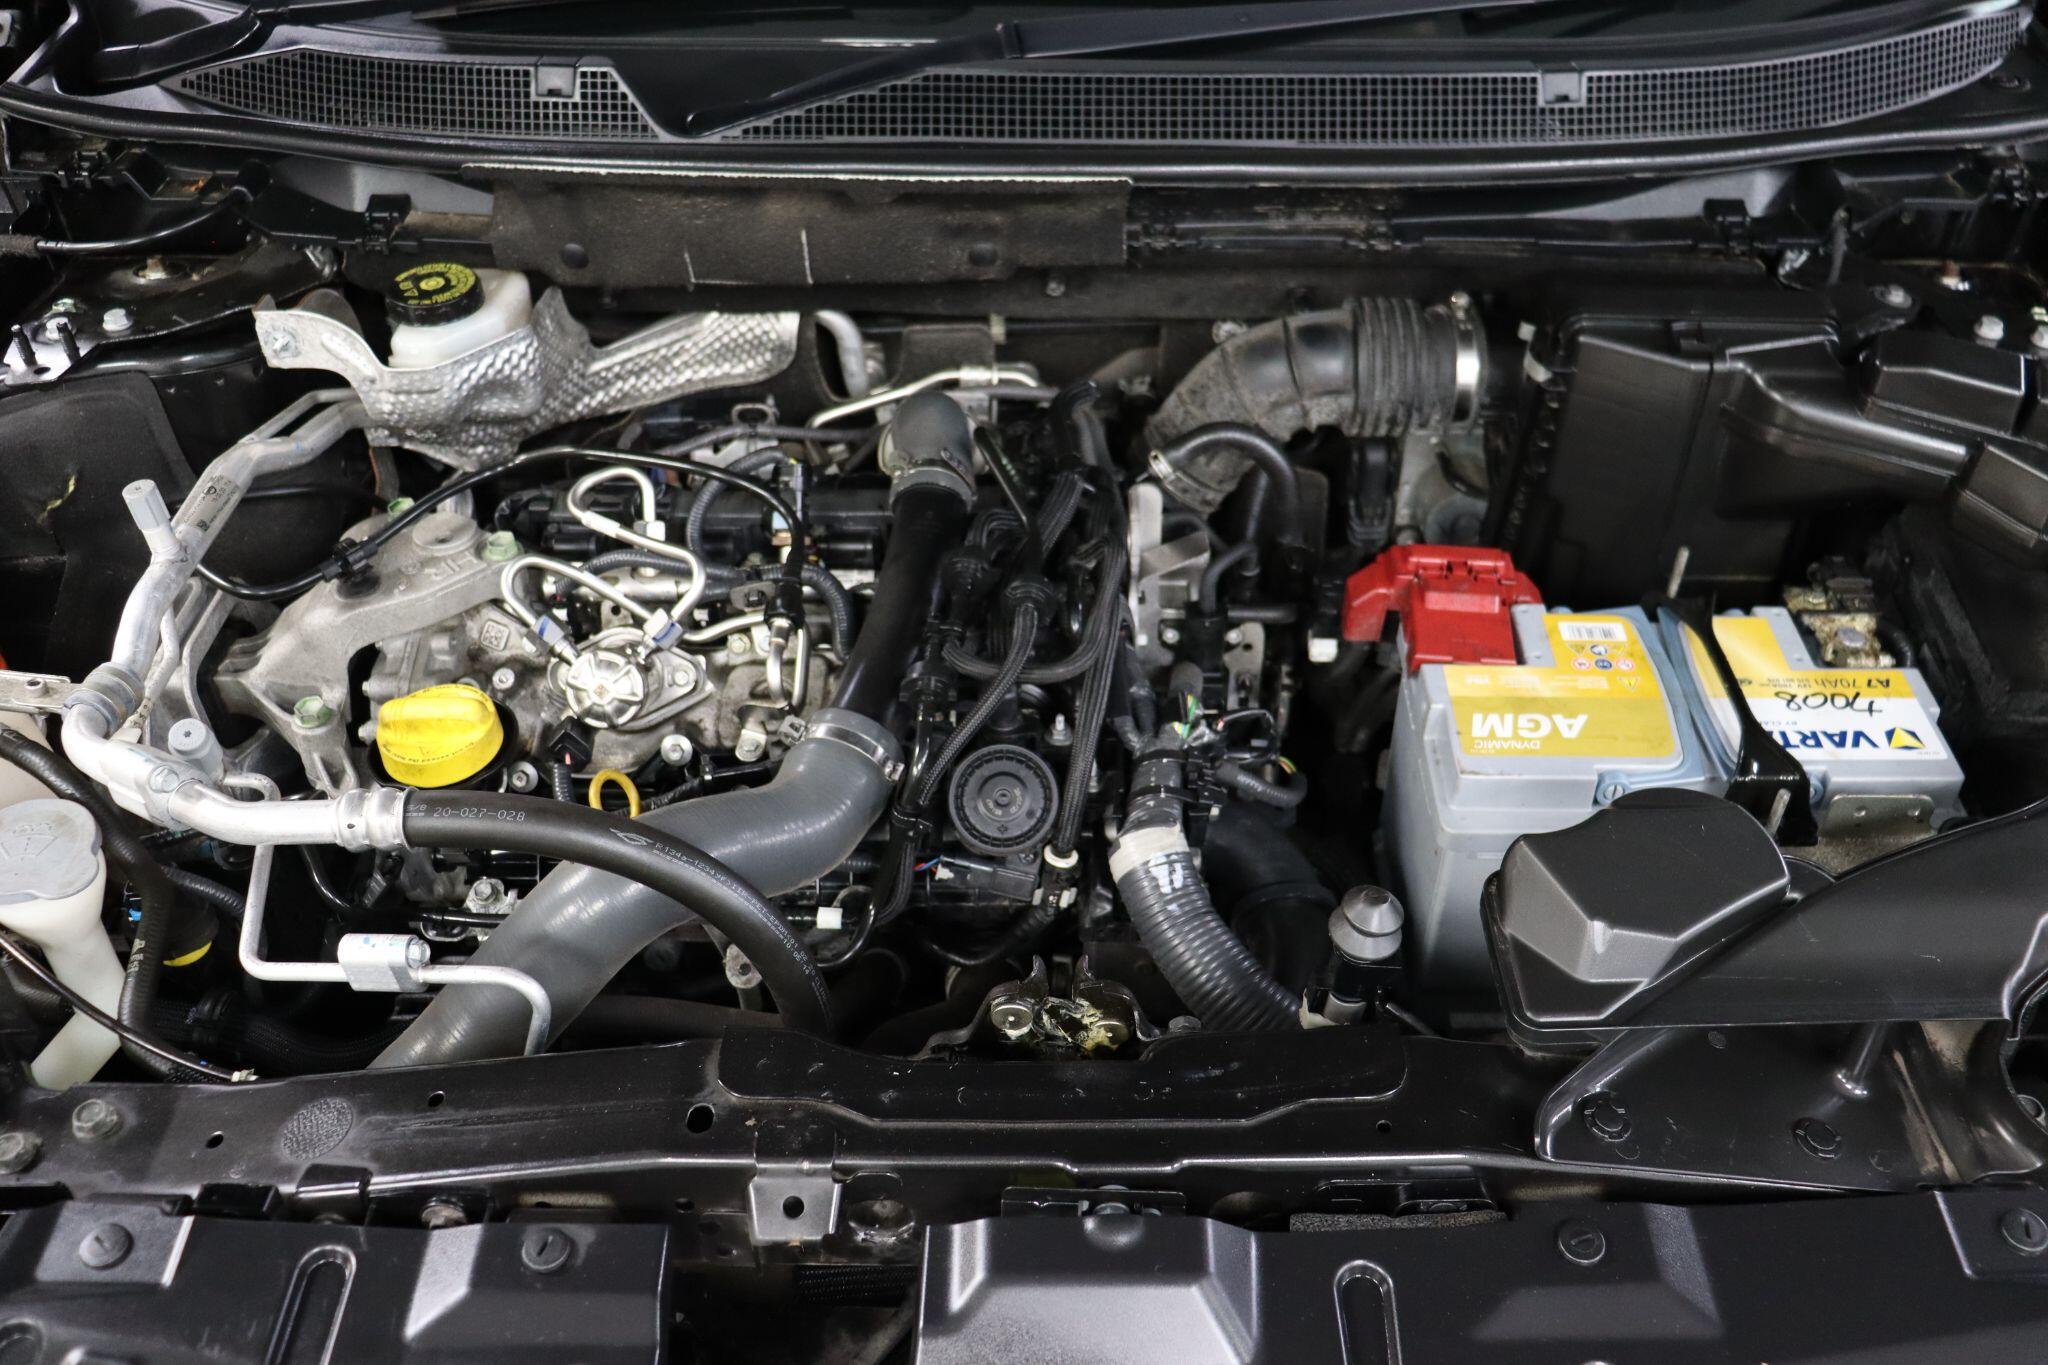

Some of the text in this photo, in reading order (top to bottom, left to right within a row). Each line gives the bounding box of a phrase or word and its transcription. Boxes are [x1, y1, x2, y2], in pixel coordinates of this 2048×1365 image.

[1814, 677, 1861, 689] 70Ah
[1866, 678, 1890, 688] A7
[1471, 713, 1588, 739] AGM
[1474, 739, 1541, 749] DYNAMIC
[433, 807, 526, 822] 20-027-028
